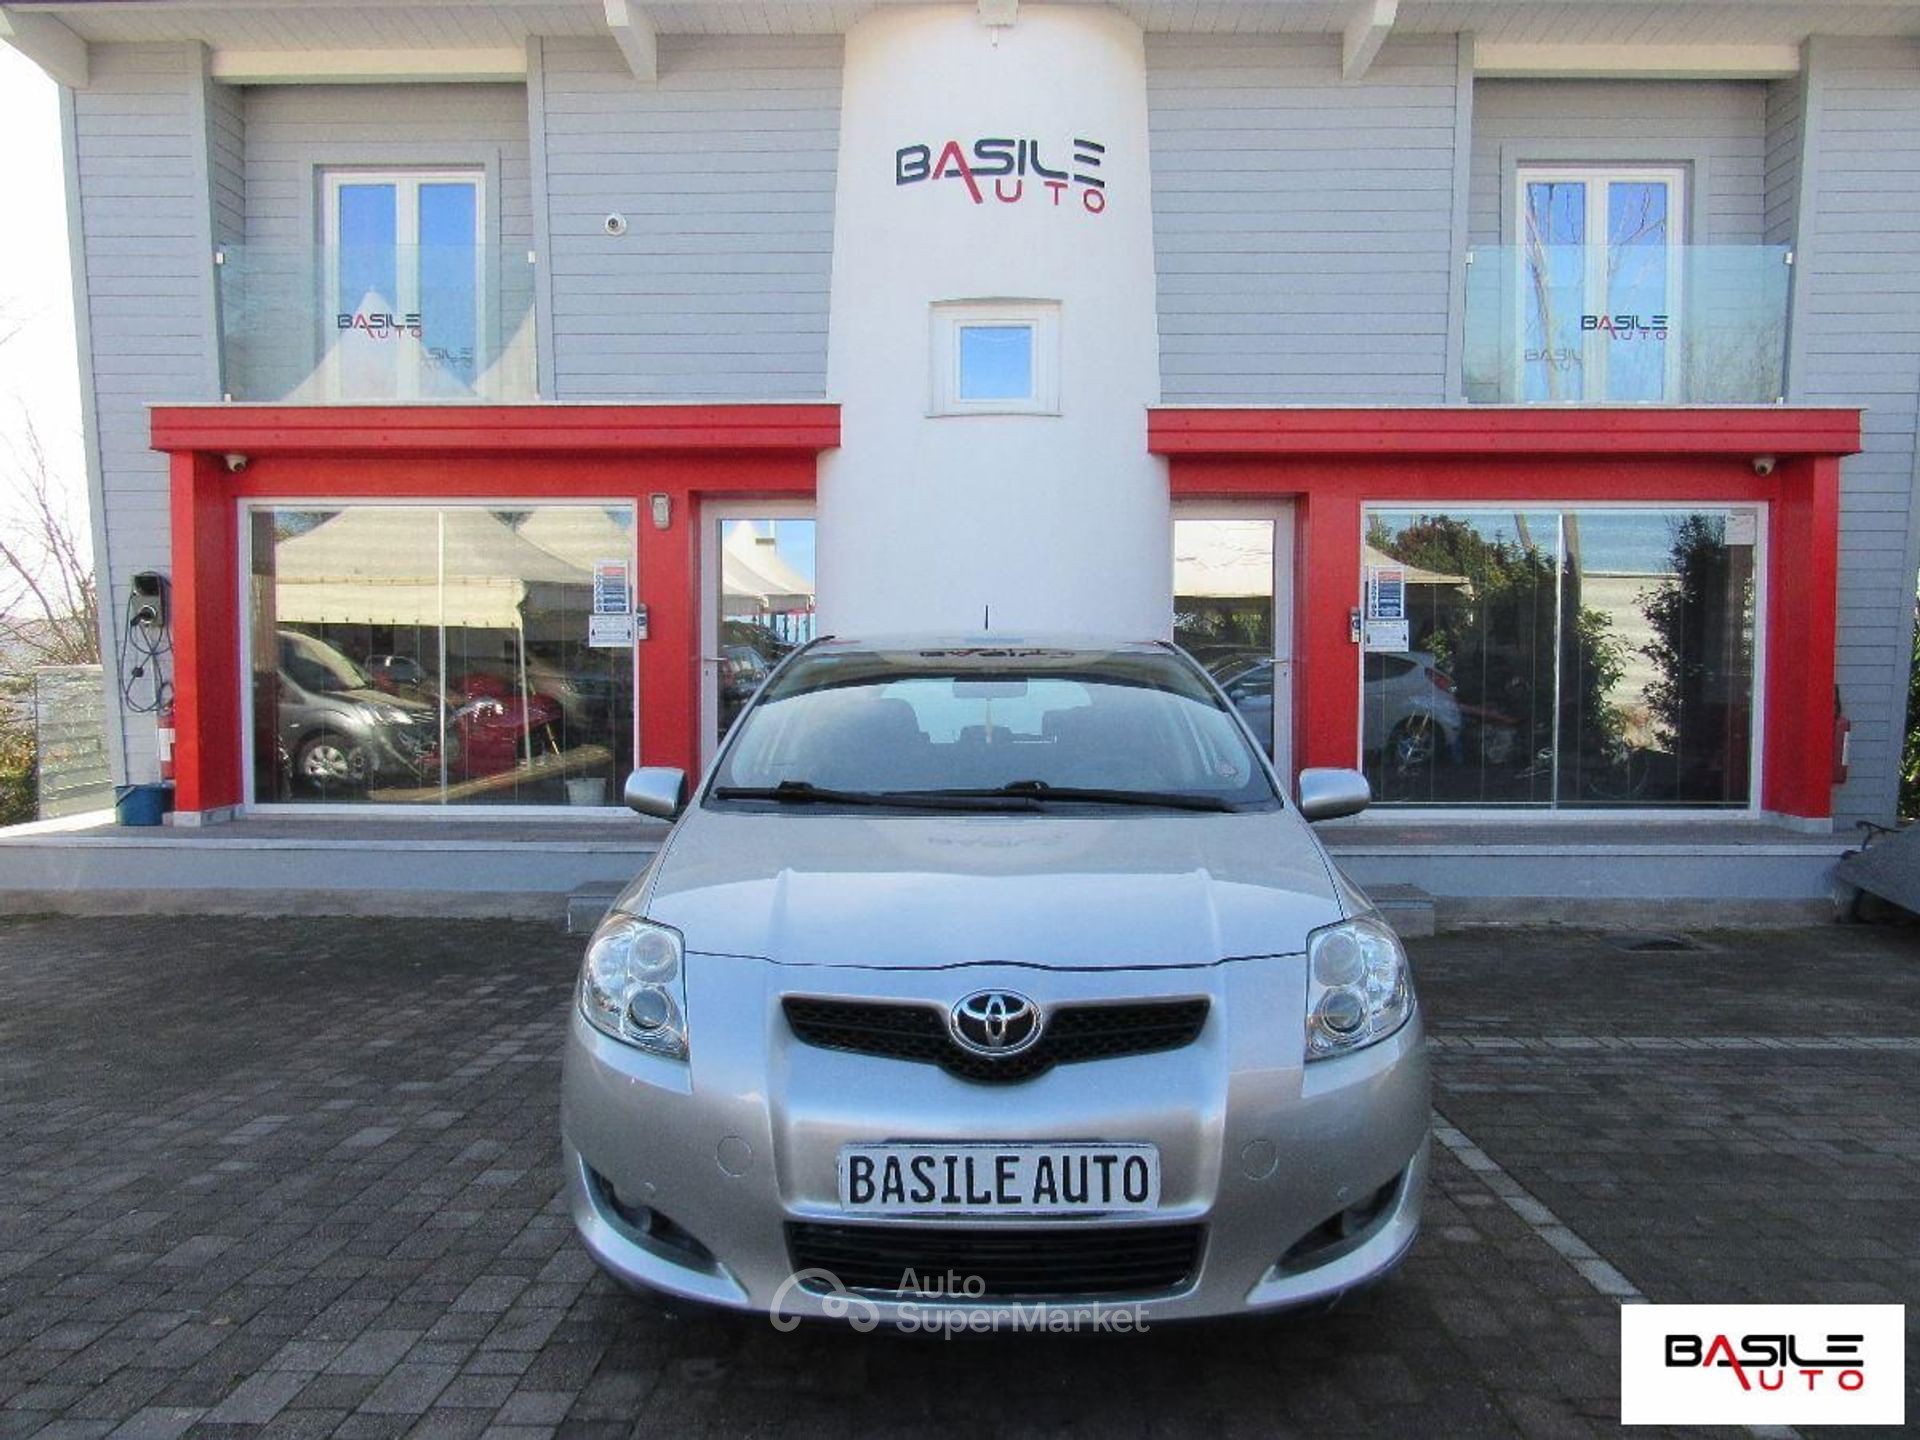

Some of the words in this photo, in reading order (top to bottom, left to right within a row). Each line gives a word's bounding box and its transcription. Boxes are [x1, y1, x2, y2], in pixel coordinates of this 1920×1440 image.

[896, 139, 1105, 188] BASILE
[337, 313, 421, 329] BASILE
[1581, 315, 1669, 330] BASILE
[849, 1155, 1022, 1204] BASILE
[1033, 1155, 1149, 1204] AUTO
